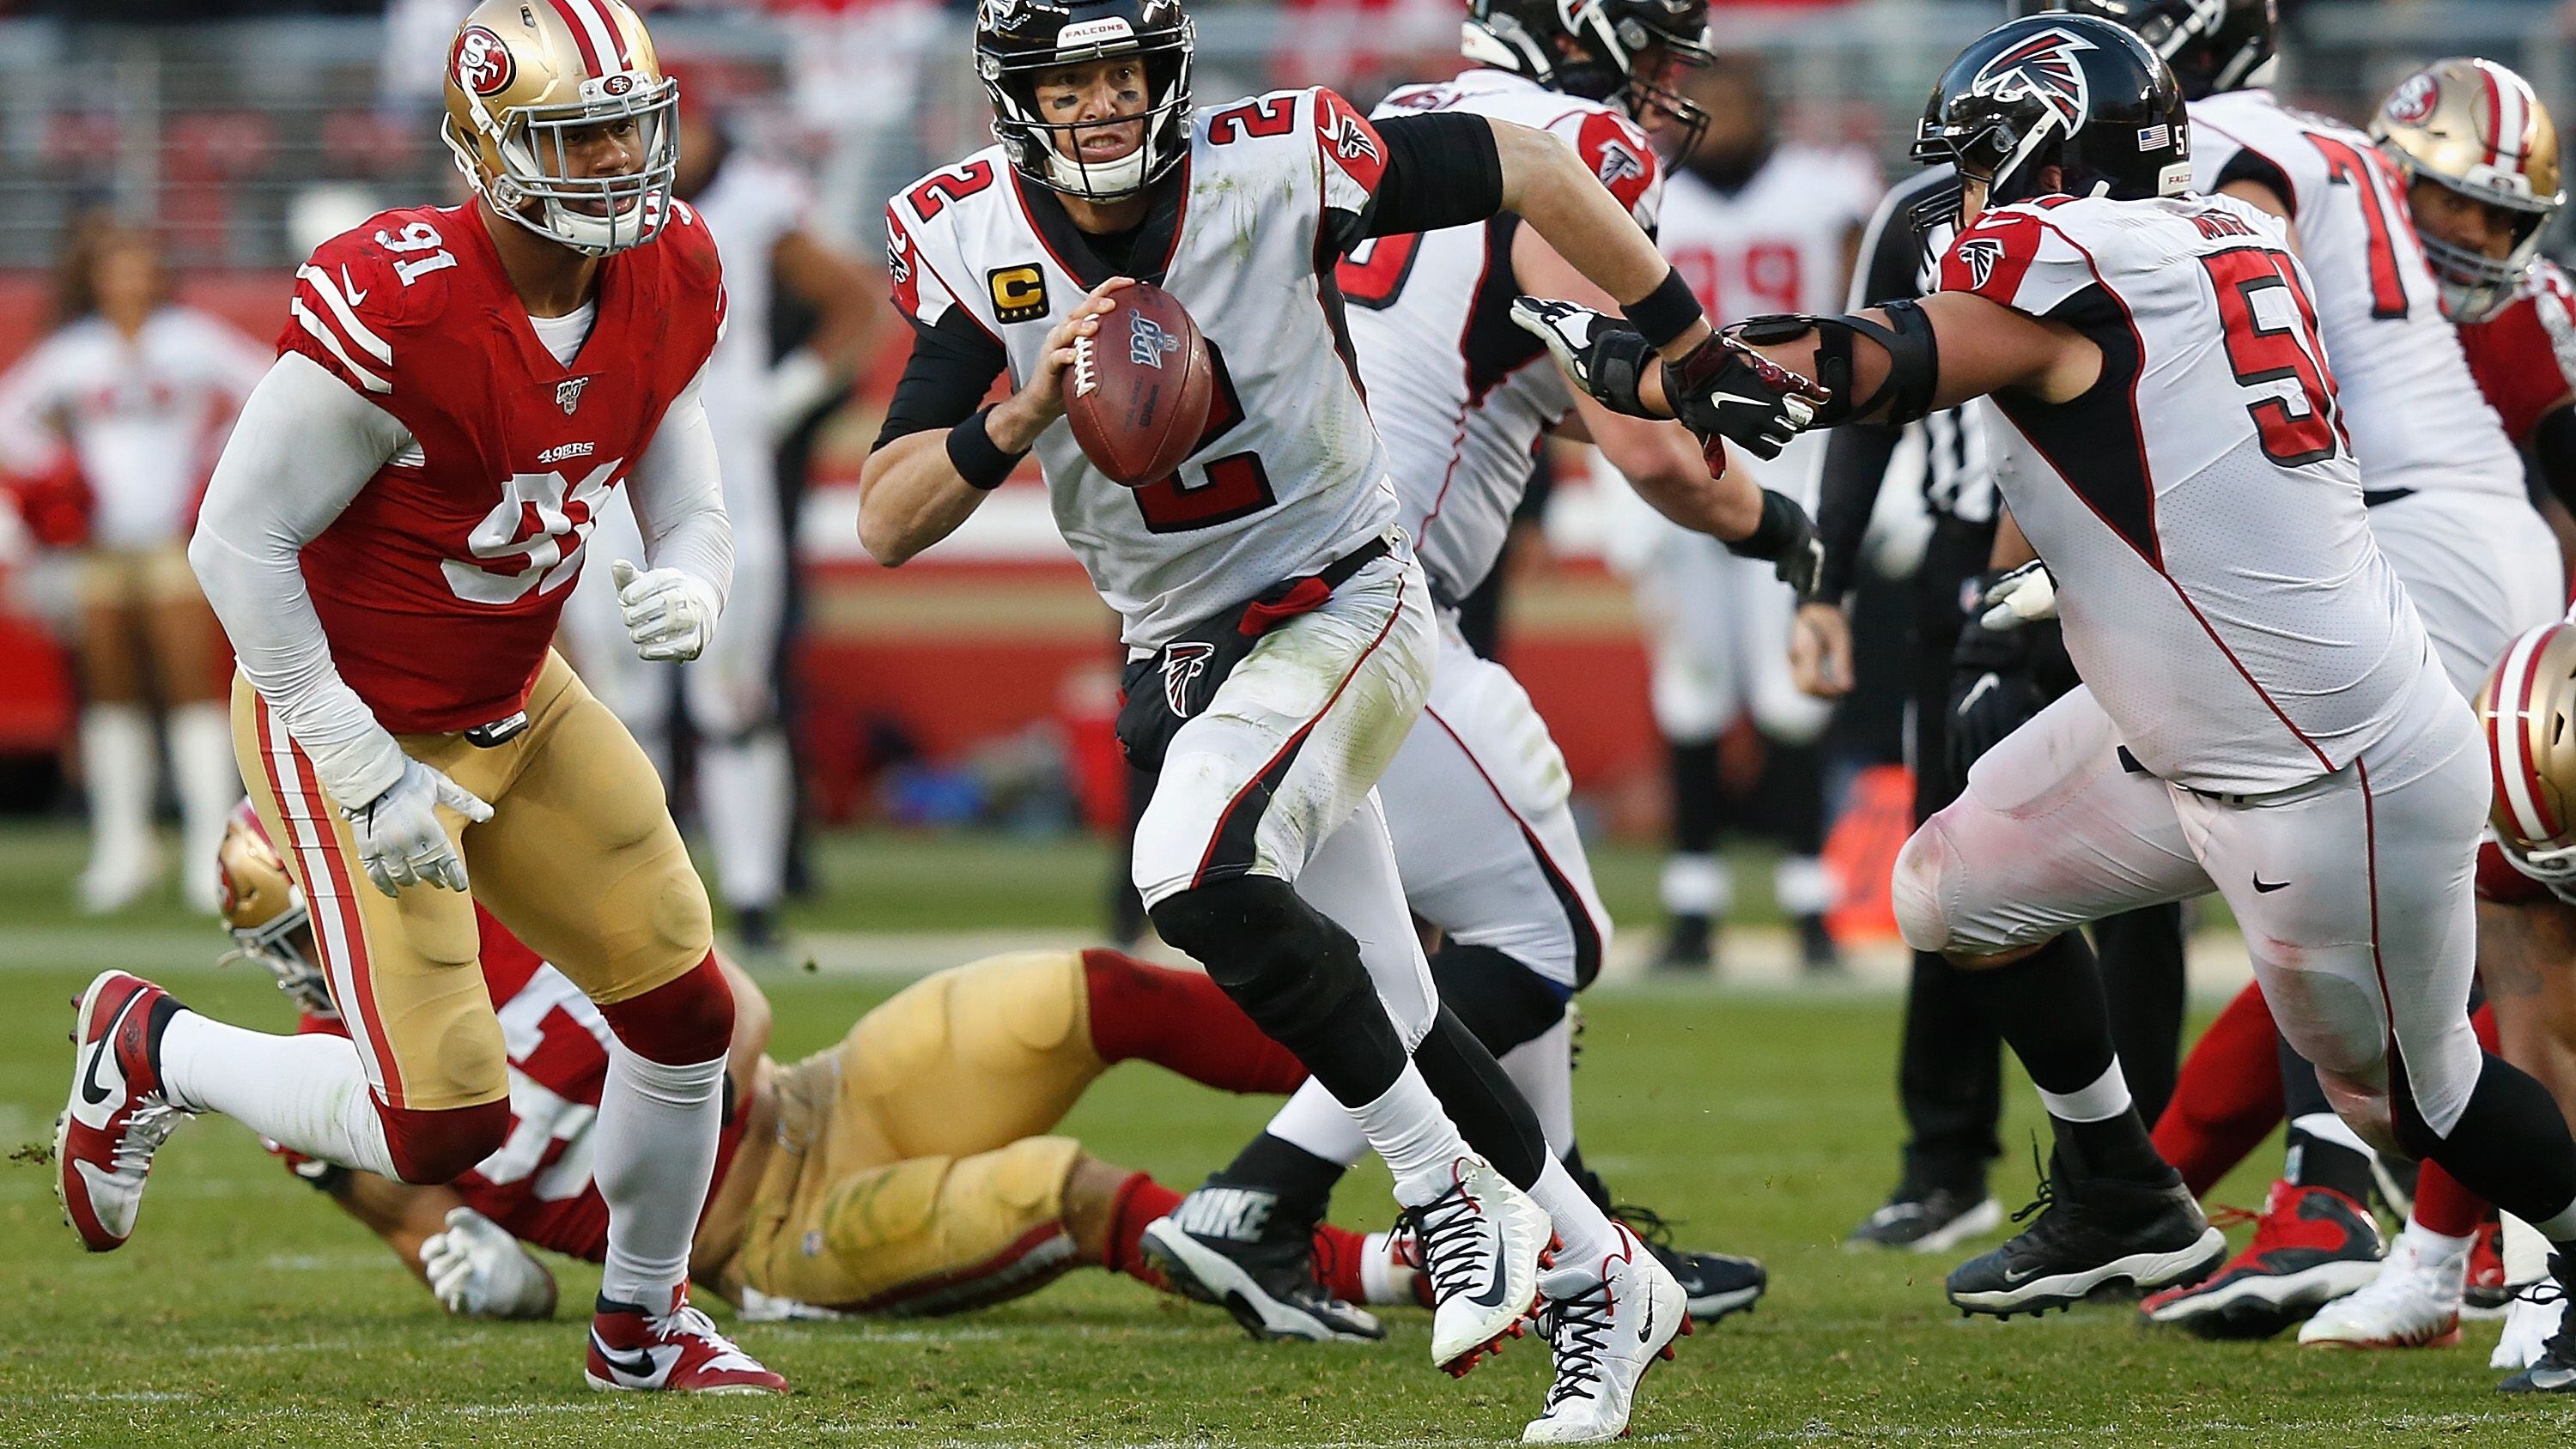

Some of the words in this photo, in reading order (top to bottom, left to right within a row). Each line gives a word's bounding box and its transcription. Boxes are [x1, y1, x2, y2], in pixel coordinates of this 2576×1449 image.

[1065, 23, 1124, 39] FALCONS
[1206, 95, 1297, 146] 2
[906, 159, 995, 224] 2
[374, 221, 459, 288] 91
[992, 267, 1042, 309] C
[537, 441, 595, 464] 49ERS
[440, 456, 624, 605] 91
[1173, 1187, 1279, 1244] NIKE
